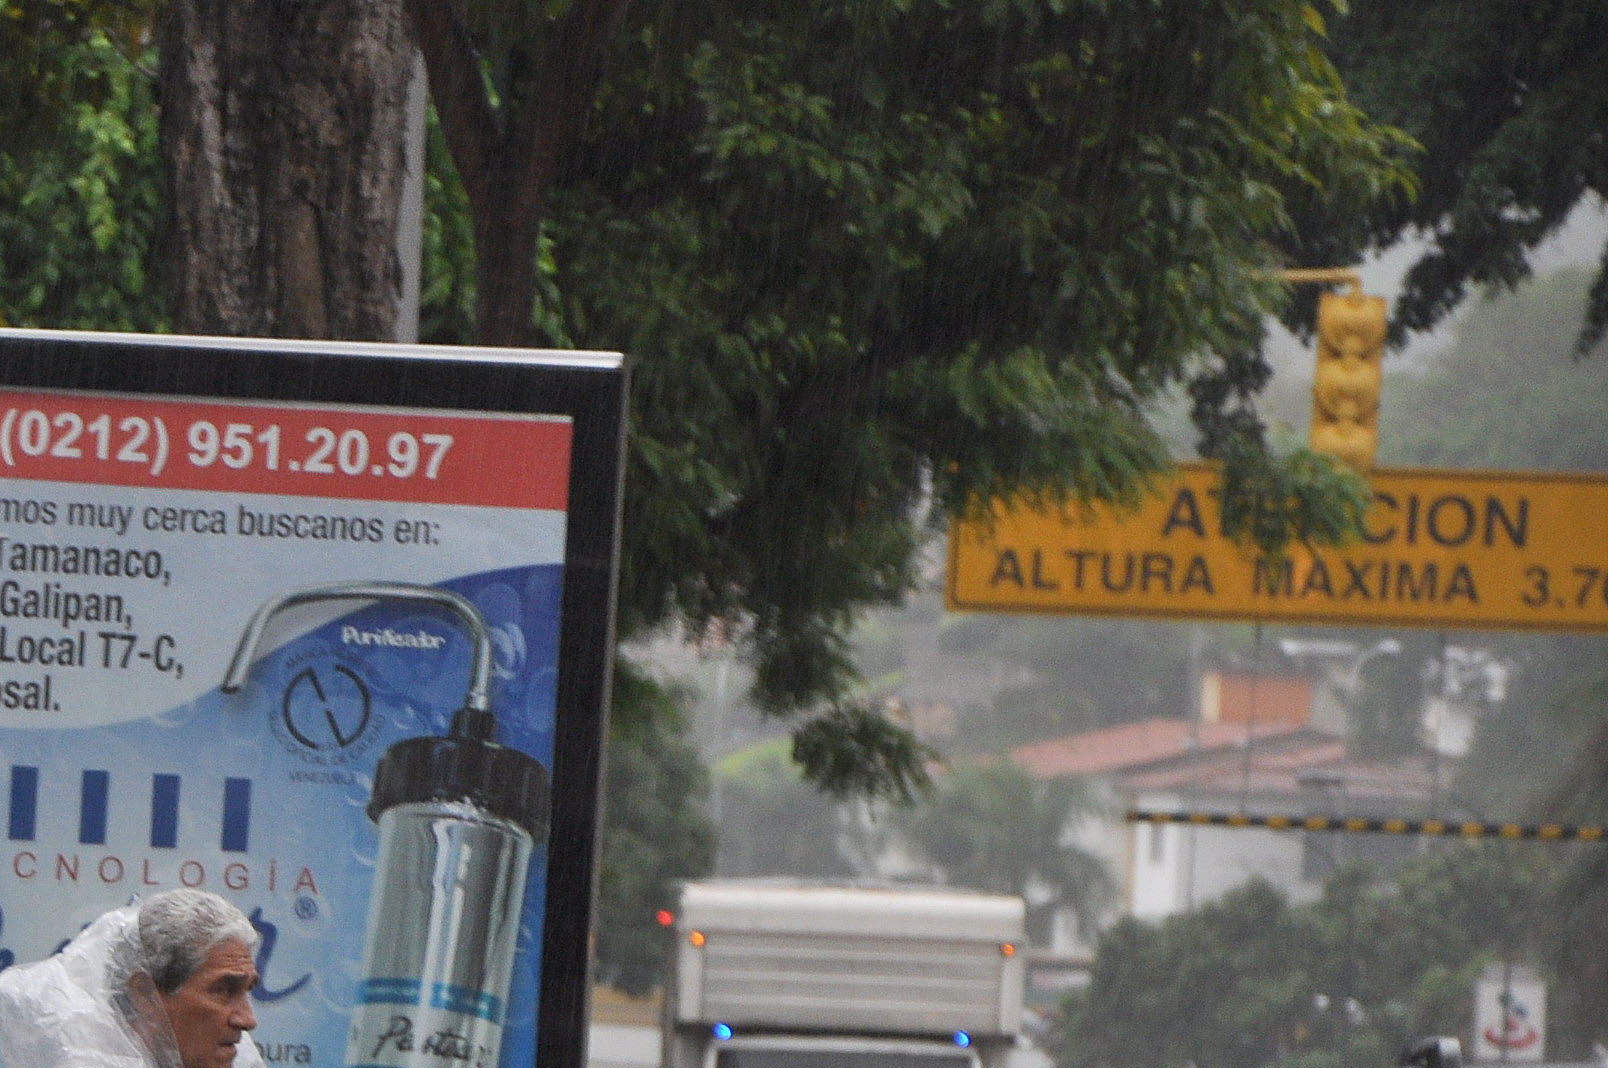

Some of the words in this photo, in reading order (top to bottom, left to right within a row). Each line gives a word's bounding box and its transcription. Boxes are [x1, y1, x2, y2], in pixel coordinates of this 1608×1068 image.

[0, 408, 169, 476] (0212)
[188, 421, 453, 480] 951.20.97
[68, 502, 133, 536] muy
[143, 505, 226, 535] cerca
[238, 505, 383, 542] buscanos
[394, 521, 441, 545] en:
[0, 581, 132, 629] Galipan,
[990, 550, 1214, 595] ALTURA
[1252, 557, 1480, 605] MAXIMA
[1522, 563, 1608, 609] 3.7
[0, 627, 85, 667] Local
[99, 632, 183, 679] T7-C,
